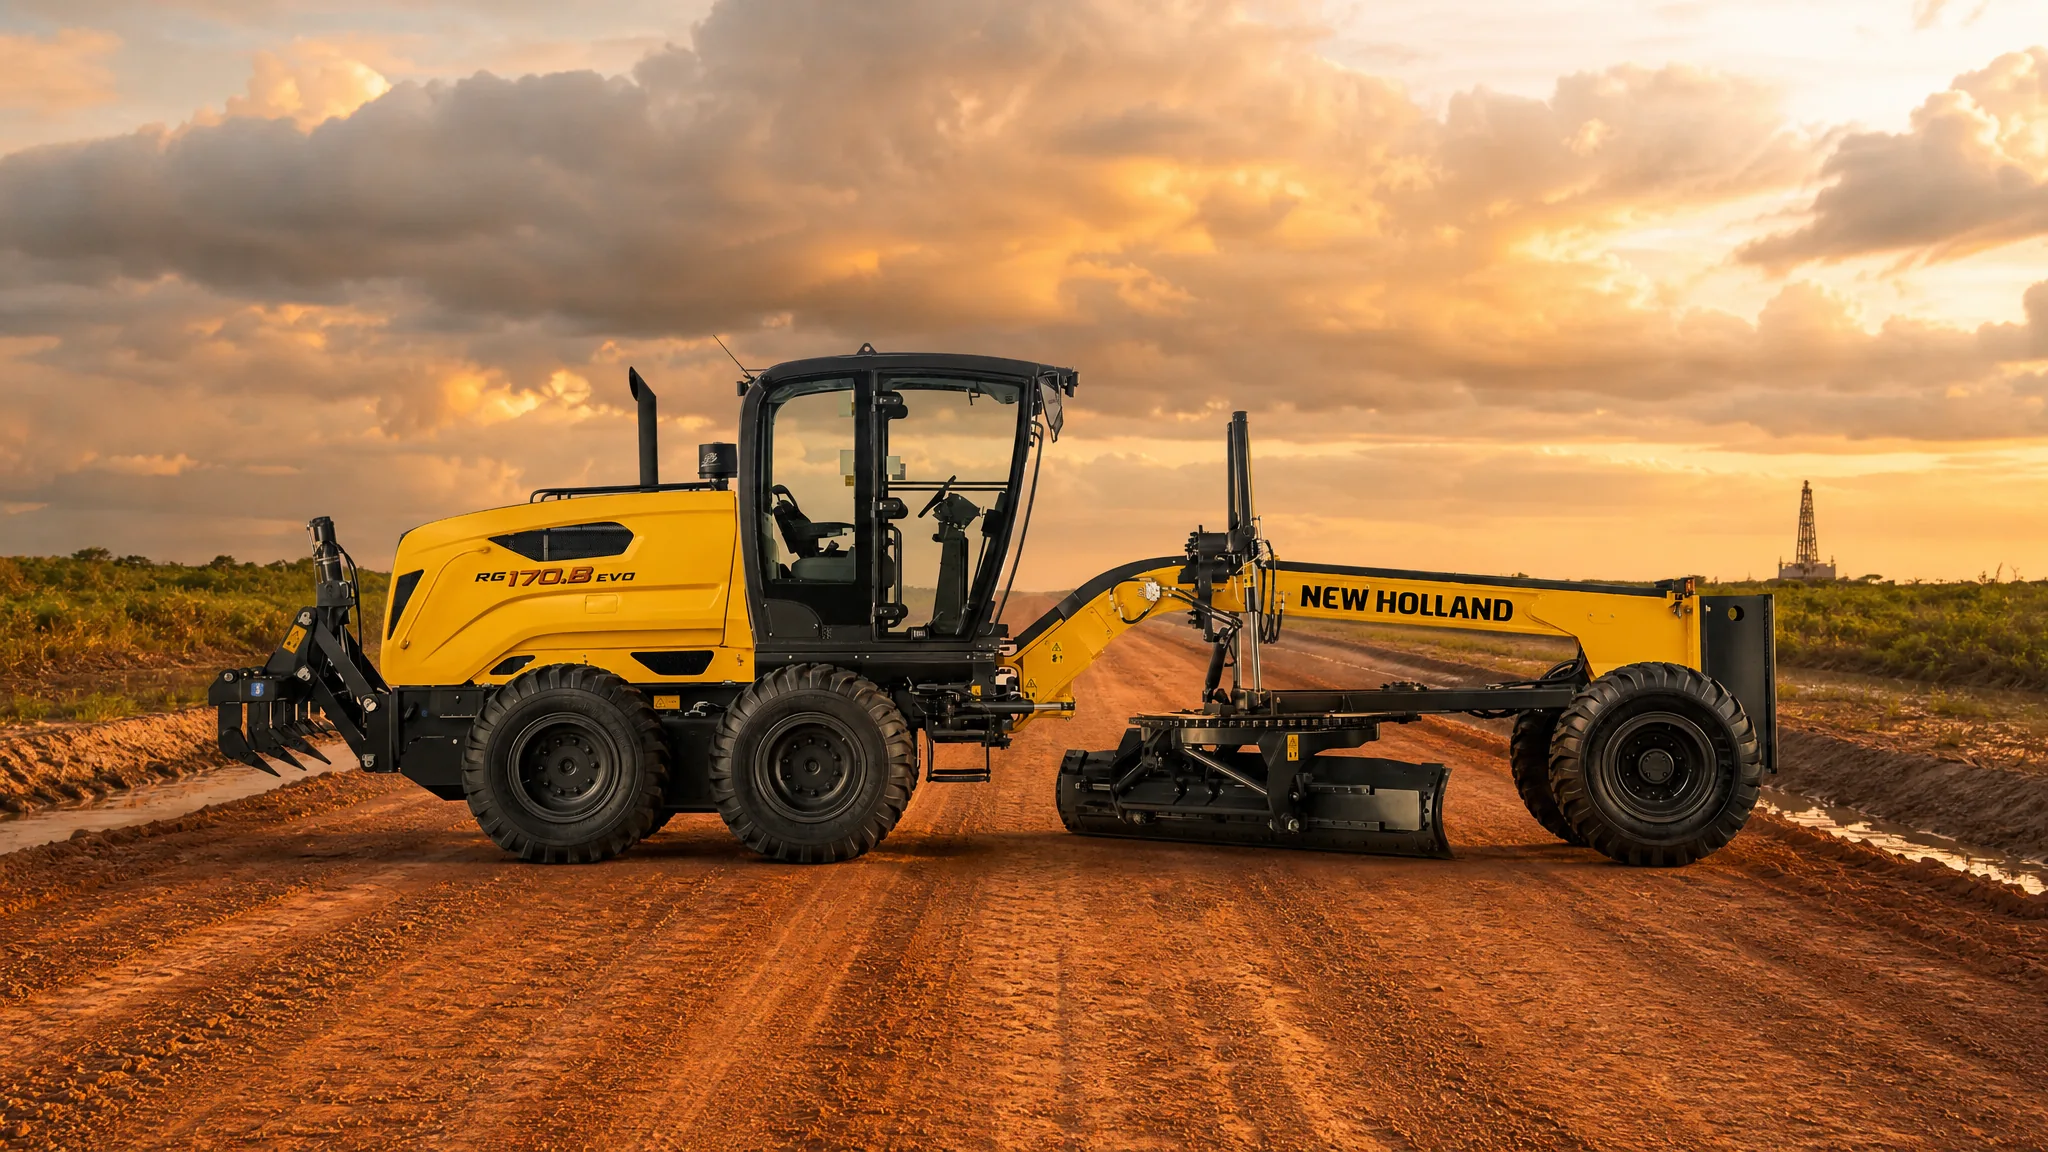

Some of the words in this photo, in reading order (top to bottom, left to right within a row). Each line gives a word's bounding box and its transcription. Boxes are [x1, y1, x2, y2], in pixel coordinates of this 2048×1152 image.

[475, 572, 506, 582] RG
[508, 566, 594, 587] 170.B
[596, 572, 636, 582] EVO
[1300, 584, 1370, 612] NEW
[1376, 589, 1513, 622] HOLLAND
